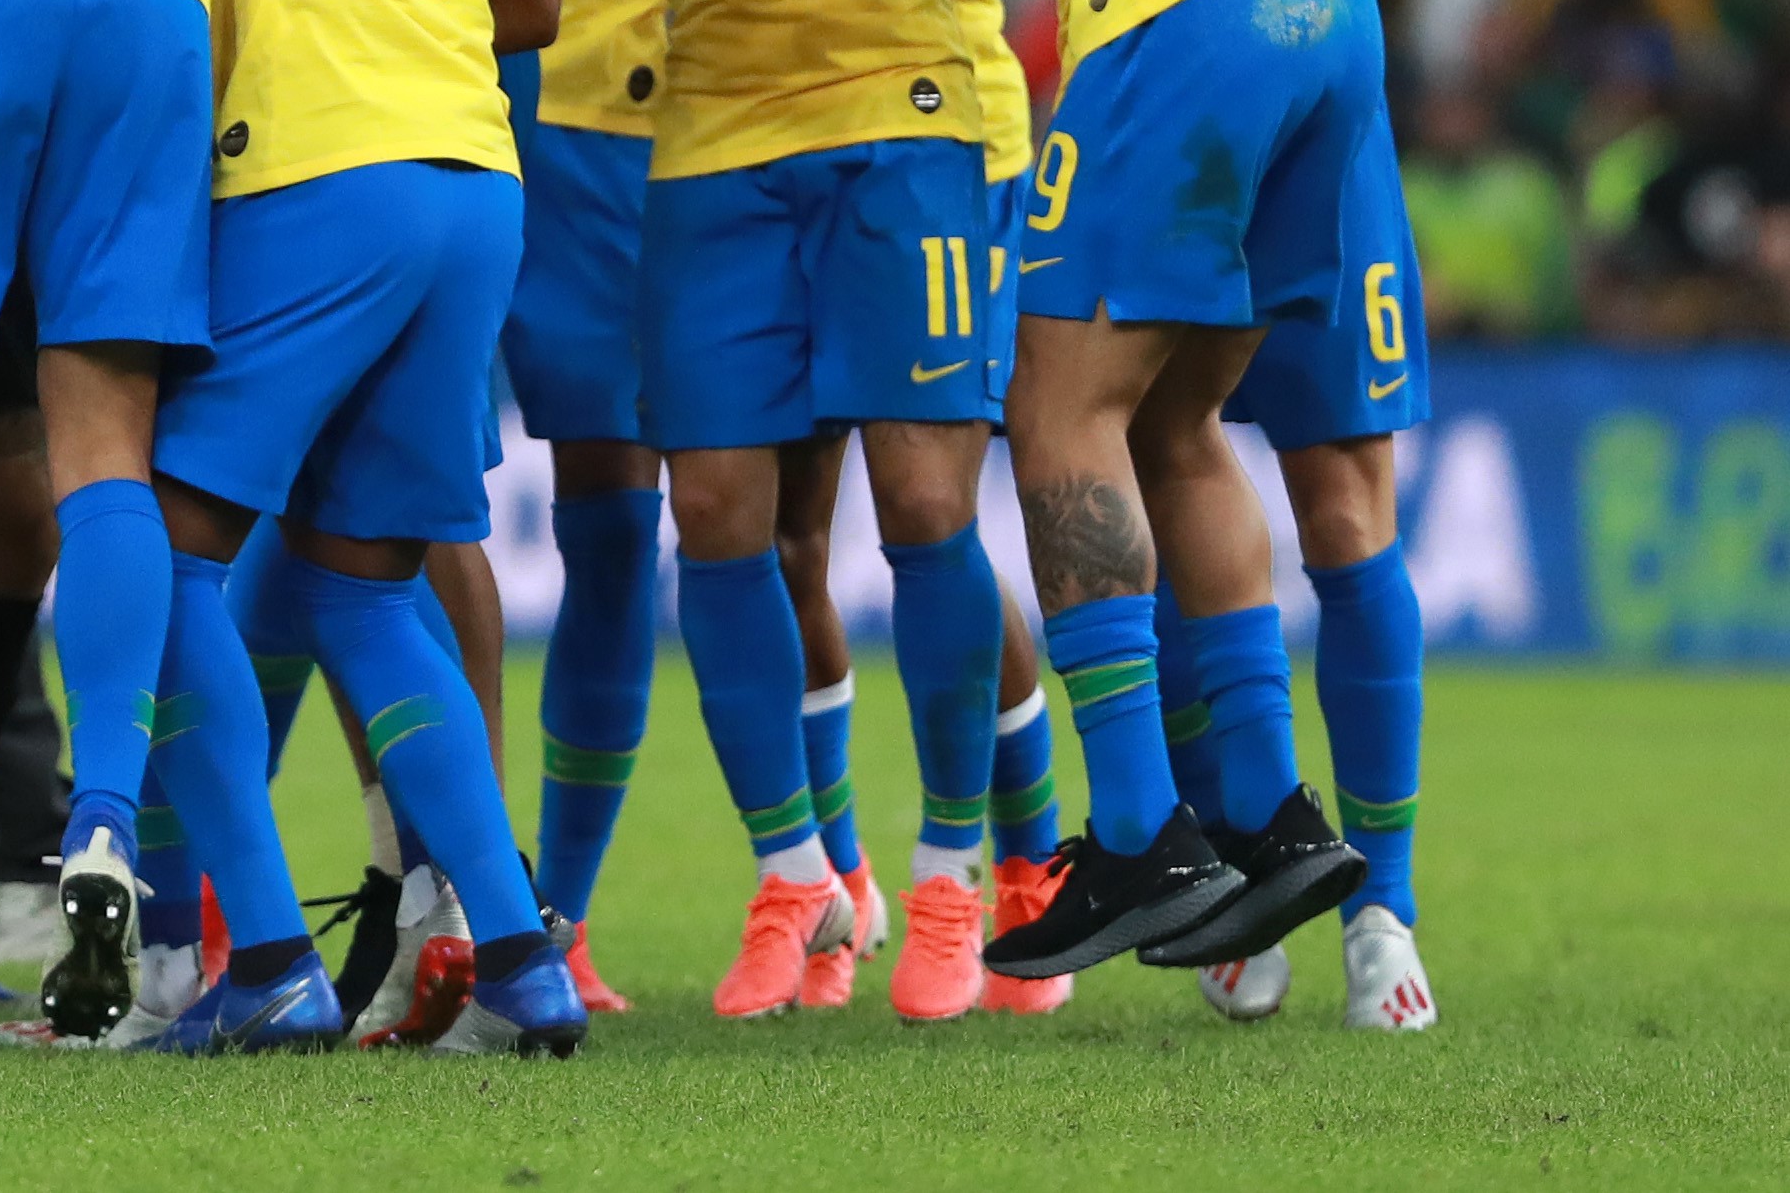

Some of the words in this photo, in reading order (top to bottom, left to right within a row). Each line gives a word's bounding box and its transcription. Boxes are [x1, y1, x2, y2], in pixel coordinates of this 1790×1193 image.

[1027, 130, 1080, 232] 9
[920, 236, 973, 338] 11
[1363, 261, 1406, 363] 6
